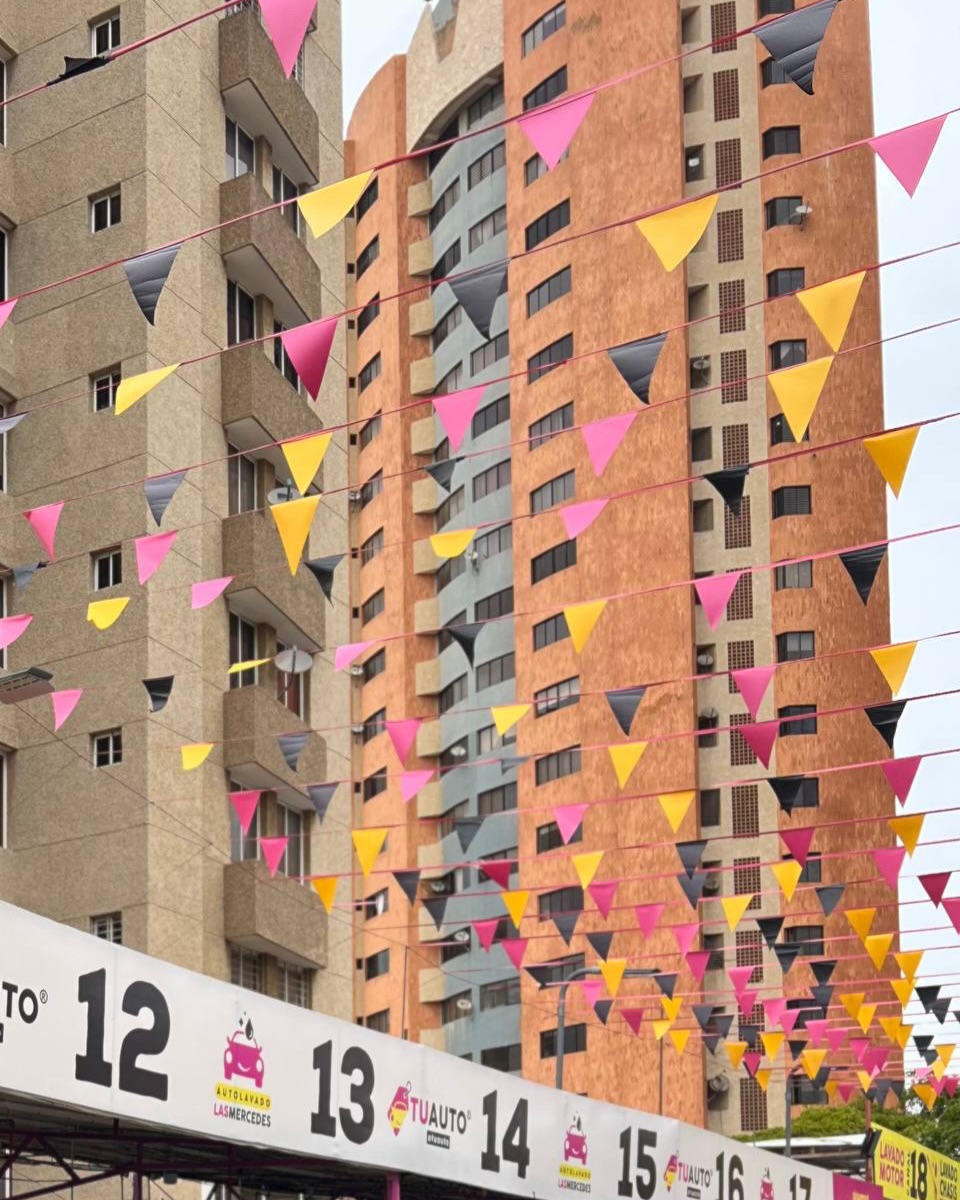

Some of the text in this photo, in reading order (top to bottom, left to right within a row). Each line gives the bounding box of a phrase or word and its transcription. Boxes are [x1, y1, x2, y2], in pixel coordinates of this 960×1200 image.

[75, 967, 171, 1102] 12
[214, 1102, 271, 1128] LASMERCEDES
[217, 1086, 271, 1108] AUTOLAVADO
[311, 1039, 376, 1145] 13
[481, 1089, 530, 1179] 14
[880, 1140, 905, 1168] LAVADO
[617, 1126, 658, 1200] 15
[880, 1162, 905, 1188] MOTOR
